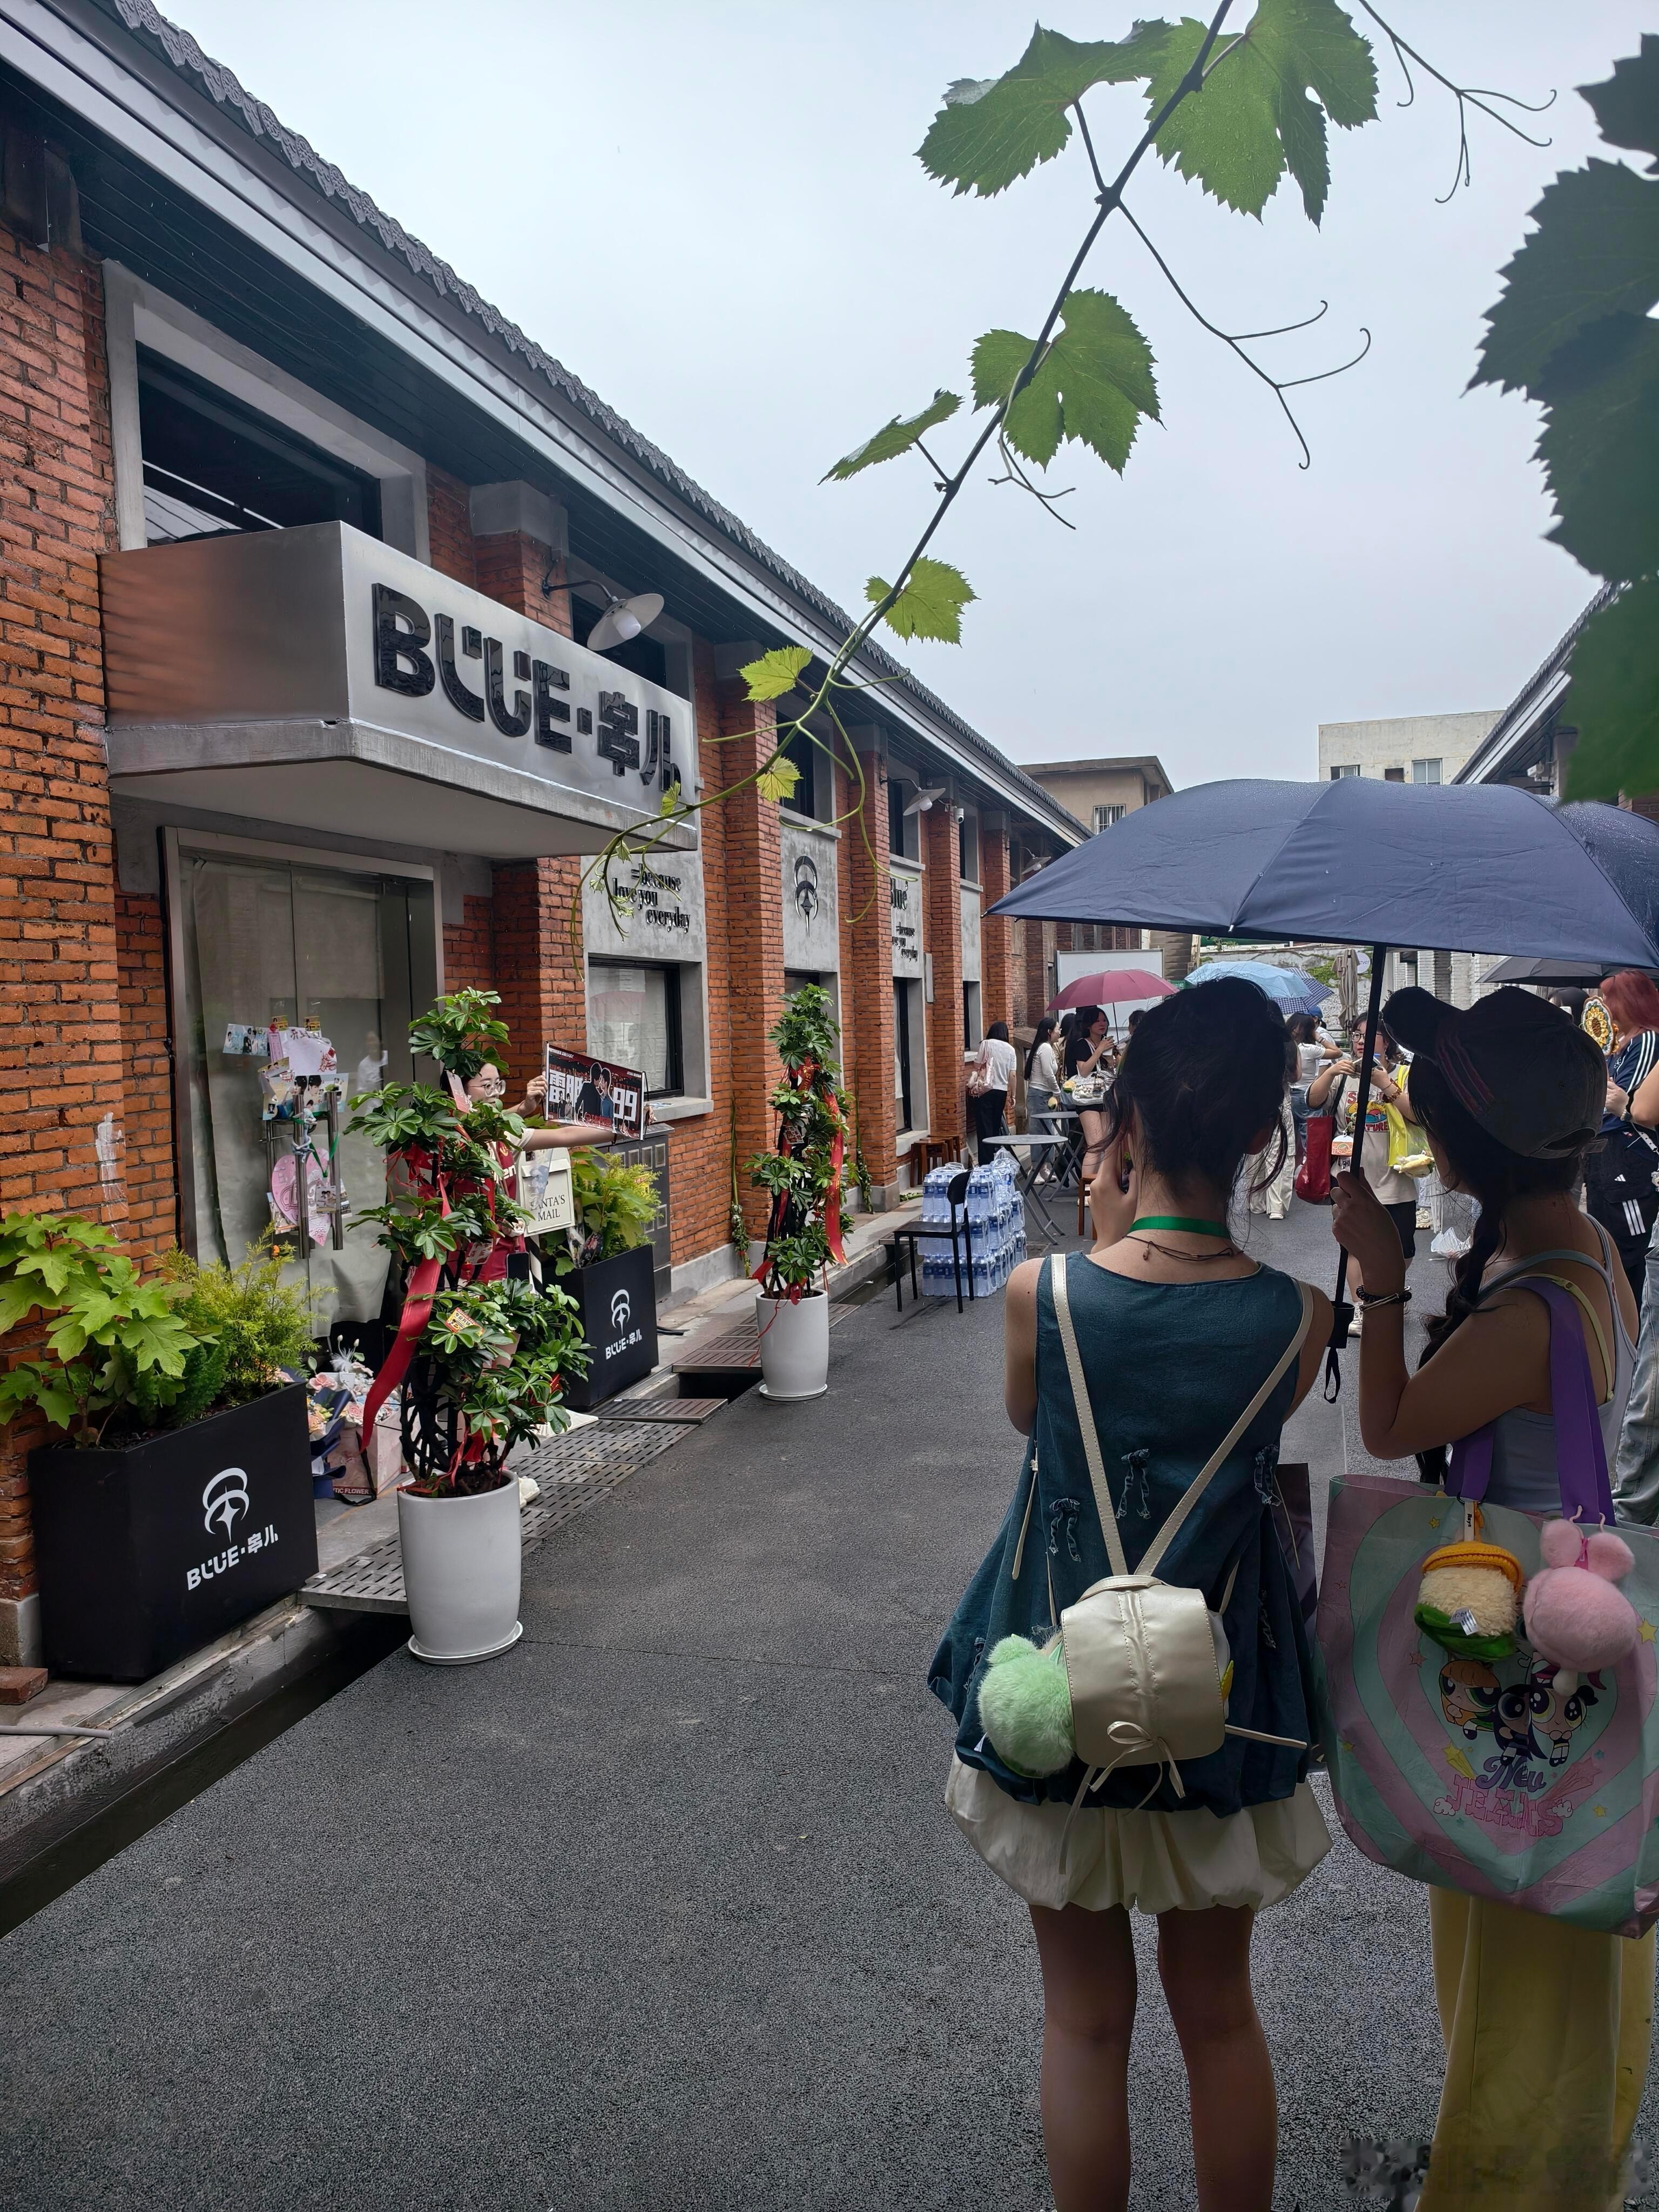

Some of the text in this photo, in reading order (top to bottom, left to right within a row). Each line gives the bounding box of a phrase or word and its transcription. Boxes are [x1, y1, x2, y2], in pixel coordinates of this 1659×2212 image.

[638, 889, 658, 910] you
[645, 907, 691, 933] everyday
[613, 1087, 638, 1122] 99
[538, 1209, 561, 1222] MAIL
